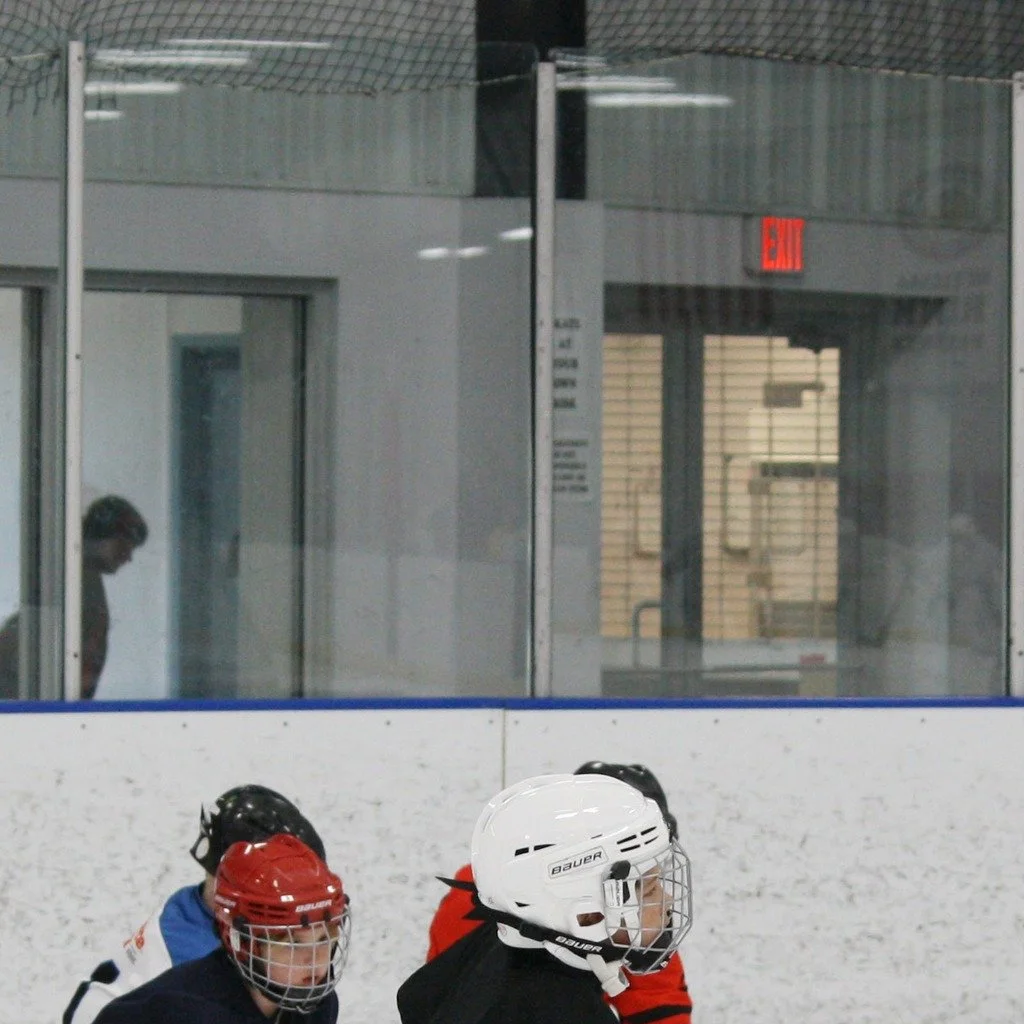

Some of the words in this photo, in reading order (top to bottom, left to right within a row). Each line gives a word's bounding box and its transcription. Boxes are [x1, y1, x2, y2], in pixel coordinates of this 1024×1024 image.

[761, 216, 804, 270] EXIT
[550, 851, 603, 876] BAUER
[555, 935, 603, 953] BAUER
